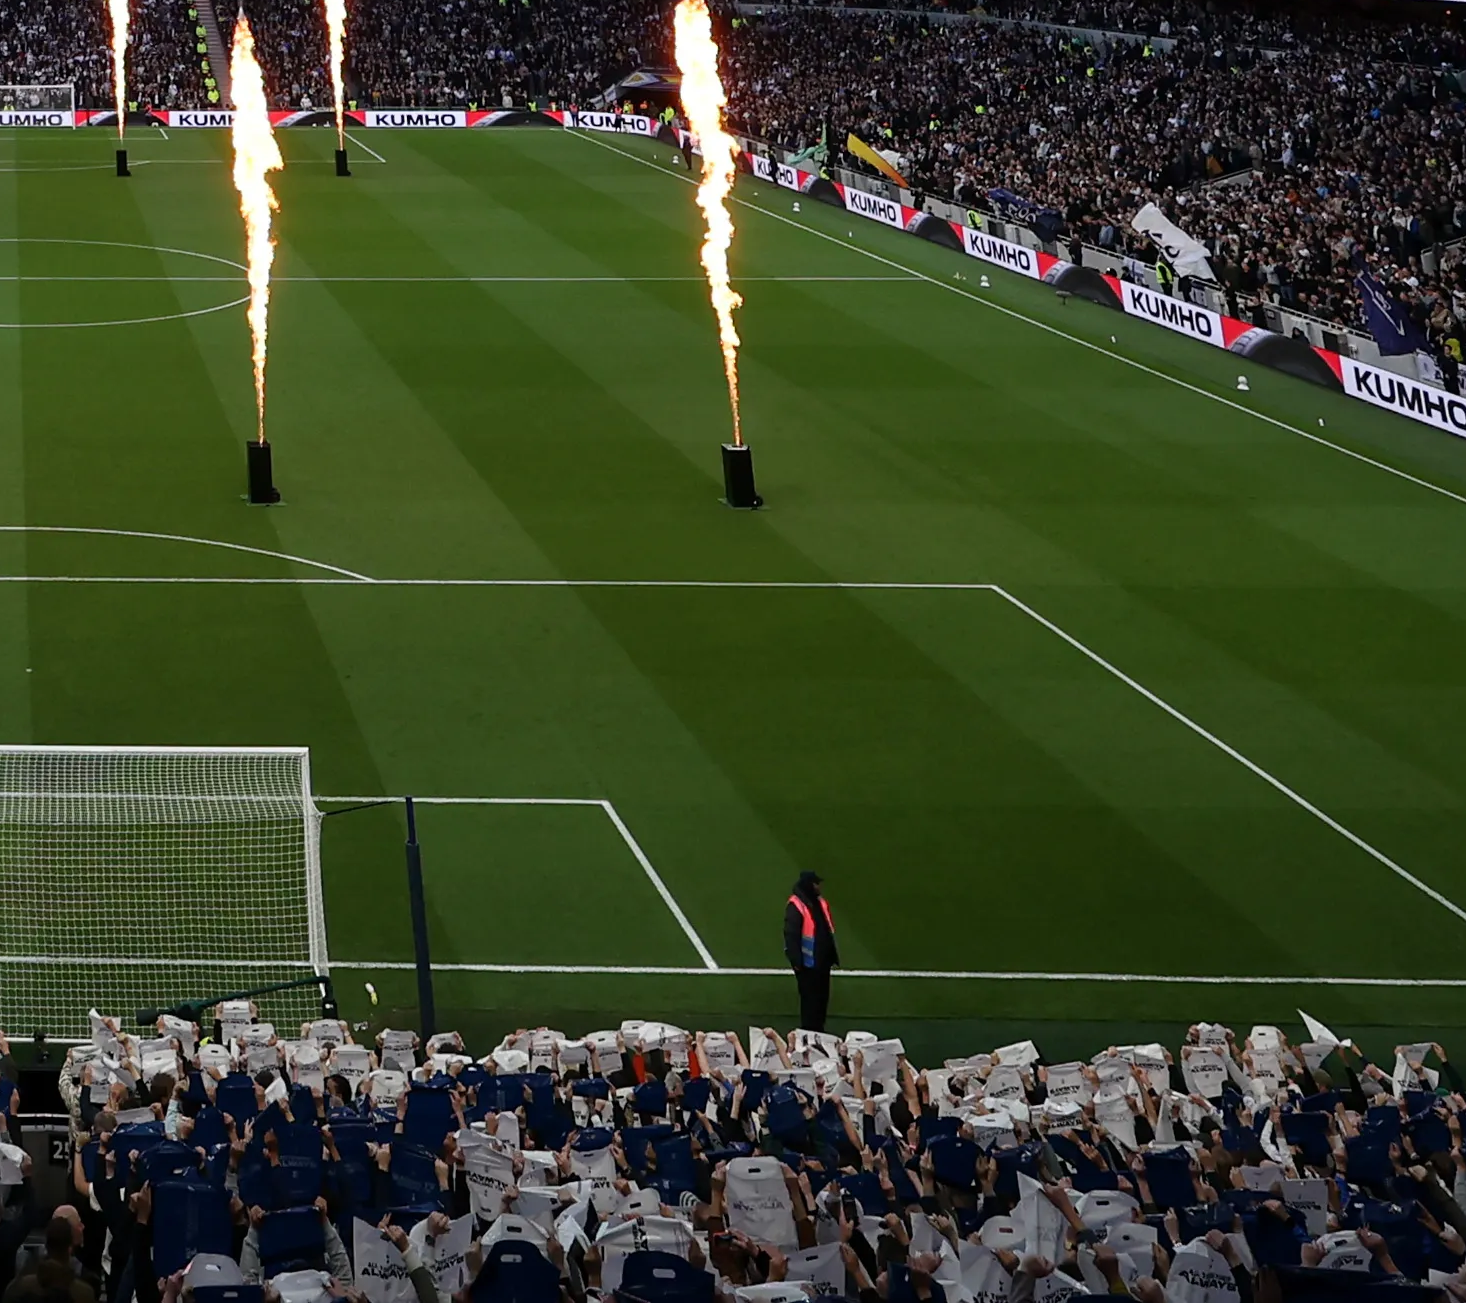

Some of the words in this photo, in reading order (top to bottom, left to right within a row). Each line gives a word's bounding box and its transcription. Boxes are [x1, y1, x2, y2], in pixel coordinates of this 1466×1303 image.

[375, 114, 456, 128] KUMHO
[850, 193, 897, 223] KUMHO
[970, 233, 1032, 272] KUMHO
[1131, 289, 1213, 338] KUMHO
